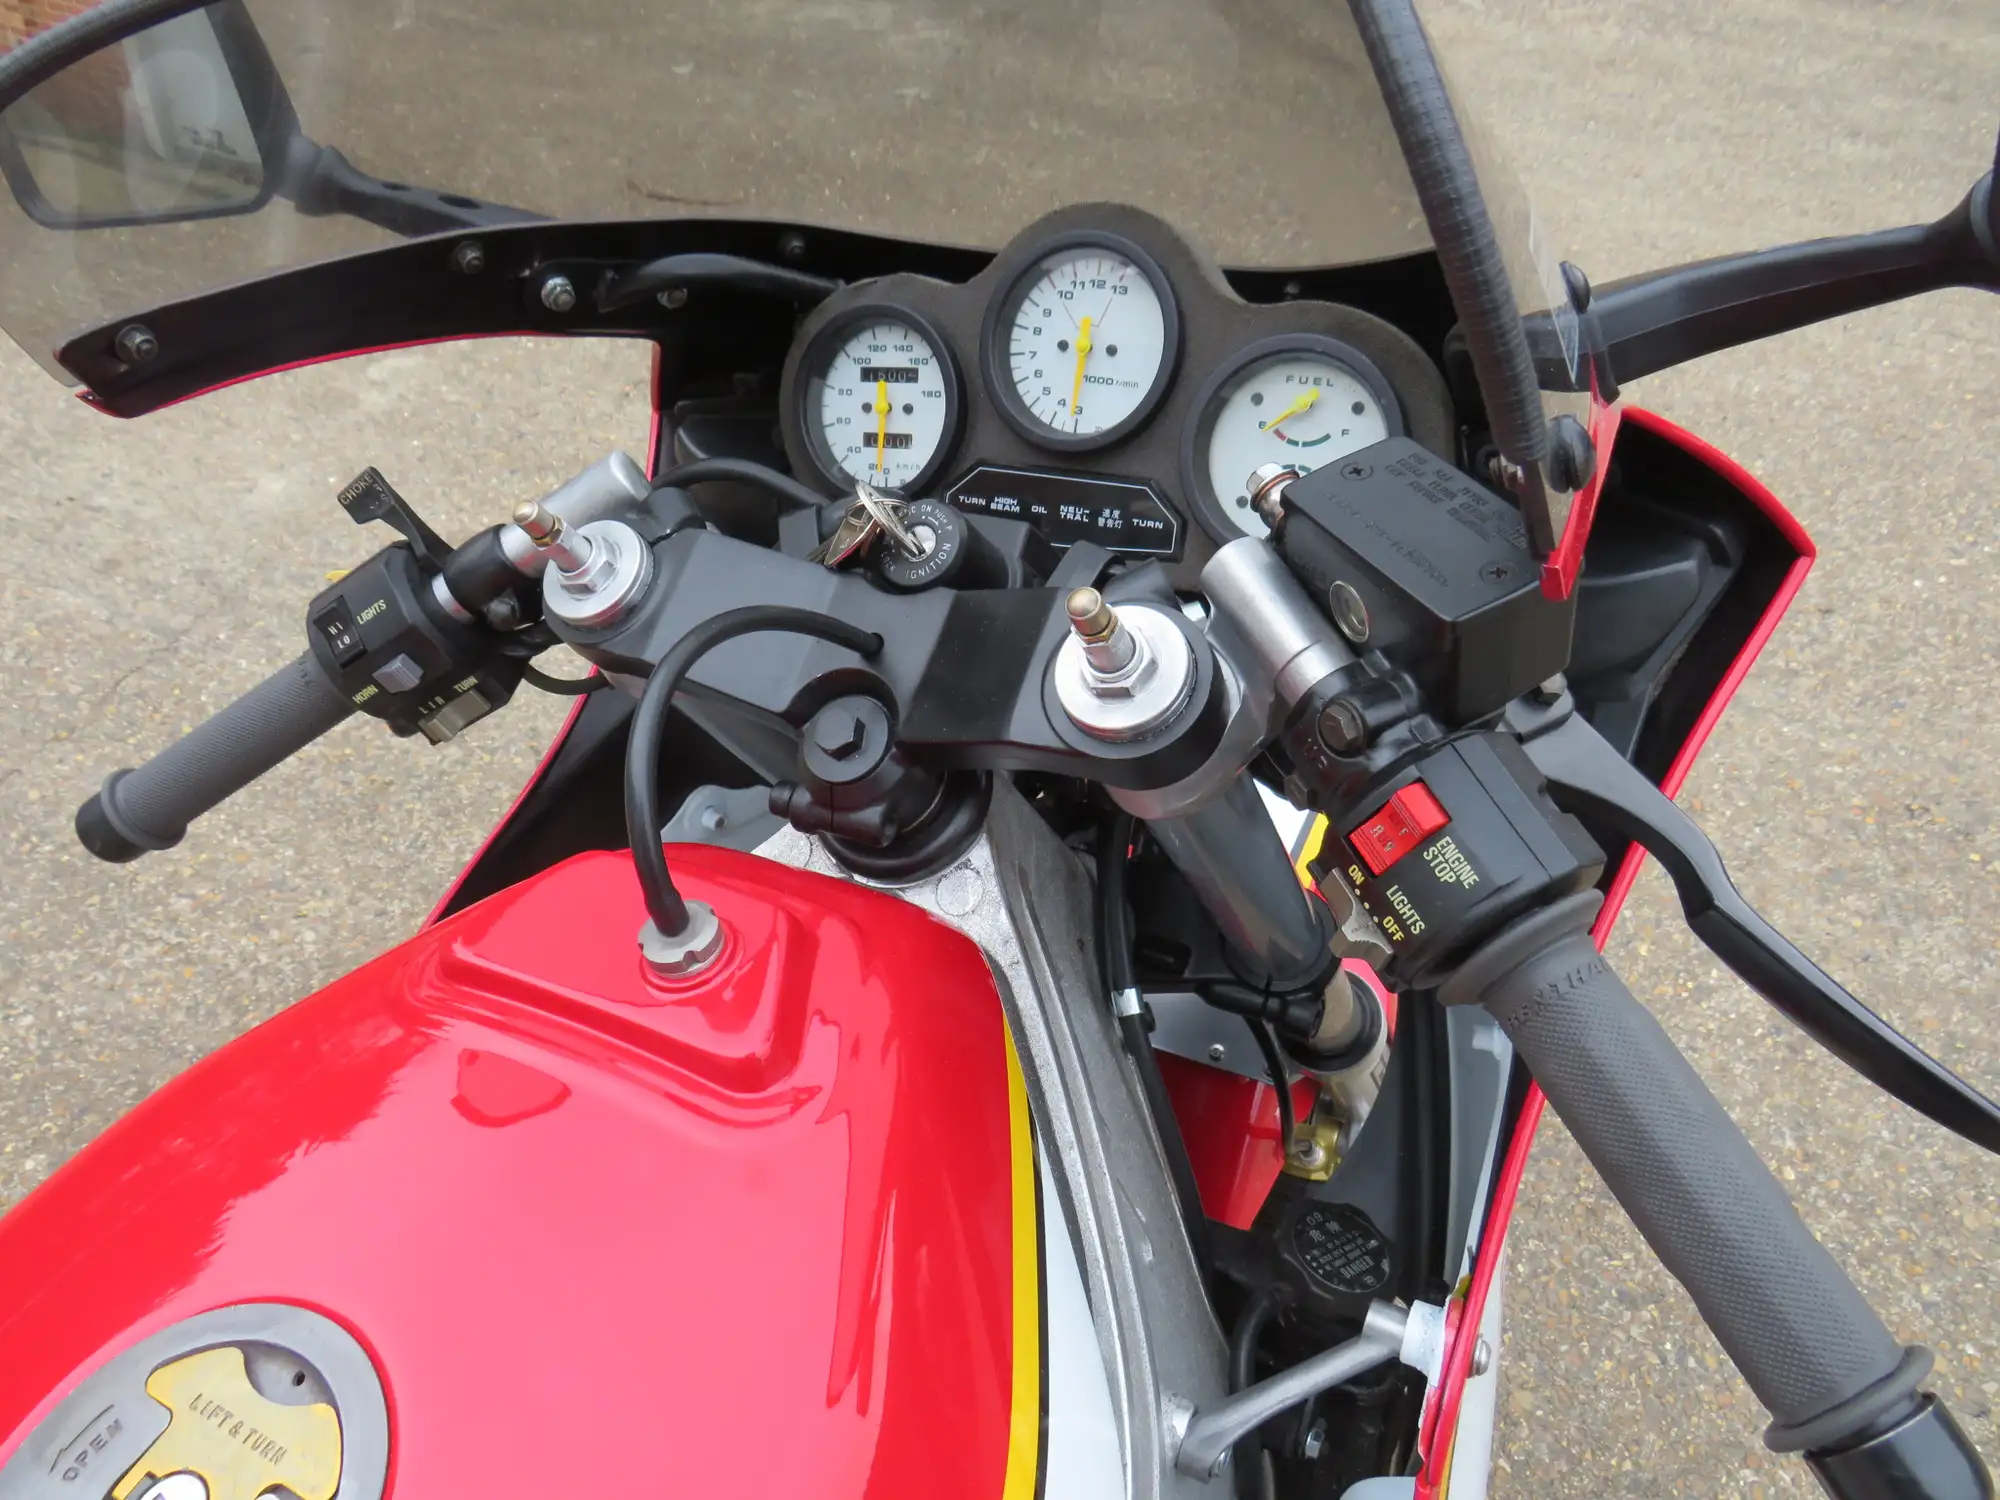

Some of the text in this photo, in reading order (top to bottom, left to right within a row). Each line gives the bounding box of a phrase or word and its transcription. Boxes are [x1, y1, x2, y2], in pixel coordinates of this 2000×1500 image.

[1070, 280, 1085, 290] 11
[1089, 279, 1106, 289] 12
[1057, 290, 1074, 300] 10
[1111, 285, 1128, 295] 13
[1043, 308, 1051, 317] 9
[1033, 327, 1042, 336] 8
[867, 344, 887, 353] 120
[893, 344, 913, 353] 140
[1028, 351, 1037, 360] 7
[852, 357, 871, 365] 100
[1034, 369, 1043, 378] 6
[1082, 374, 1139, 389] 1000 r/min
[1285, 374, 1334, 387] FUEL
[921, 390, 942, 398] 180
[1042, 387, 1051, 395] 5
[1057, 398, 1066, 408] 4
[1074, 406, 1083, 415] 3
[1259, 421, 1267, 429] E
[1341, 429, 1350, 437] F
[846, 446, 861, 454] 40
[340, 471, 373, 504] CHOKE
[958, 495, 986, 506] TURN
[994, 496, 1018, 506] HIGH
[921, 504, 933, 512] ON
[990, 503, 1020, 513] BEAM
[1031, 505, 1047, 514] OIL
[1060, 505, 1090, 514] NEU-
[934, 509, 949, 523] PUSH
[1060, 512, 1089, 523] TRAL
[1102, 508, 1121, 519] 速度
[1132, 518, 1163, 529] TURN
[905, 543, 951, 579] IGNITION
[356, 599, 387, 625] LIGHTS
[328, 622, 344, 636] HI
[337, 635, 351, 649] LO
[453, 675, 479, 693] TURN
[352, 684, 379, 704] HORN
[1423, 846, 1457, 884] STOP
[1436, 836, 1480, 889] ENGINE
[1348, 864, 1365, 885] ON
[1386, 885, 1425, 935] LIGHTS
[1382, 915, 1405, 942] OFF
[1340, 1255, 1375, 1279] DANGER
[188, 1393, 288, 1467] LIFT & TURN
[62, 1417, 124, 1482] OPEN
